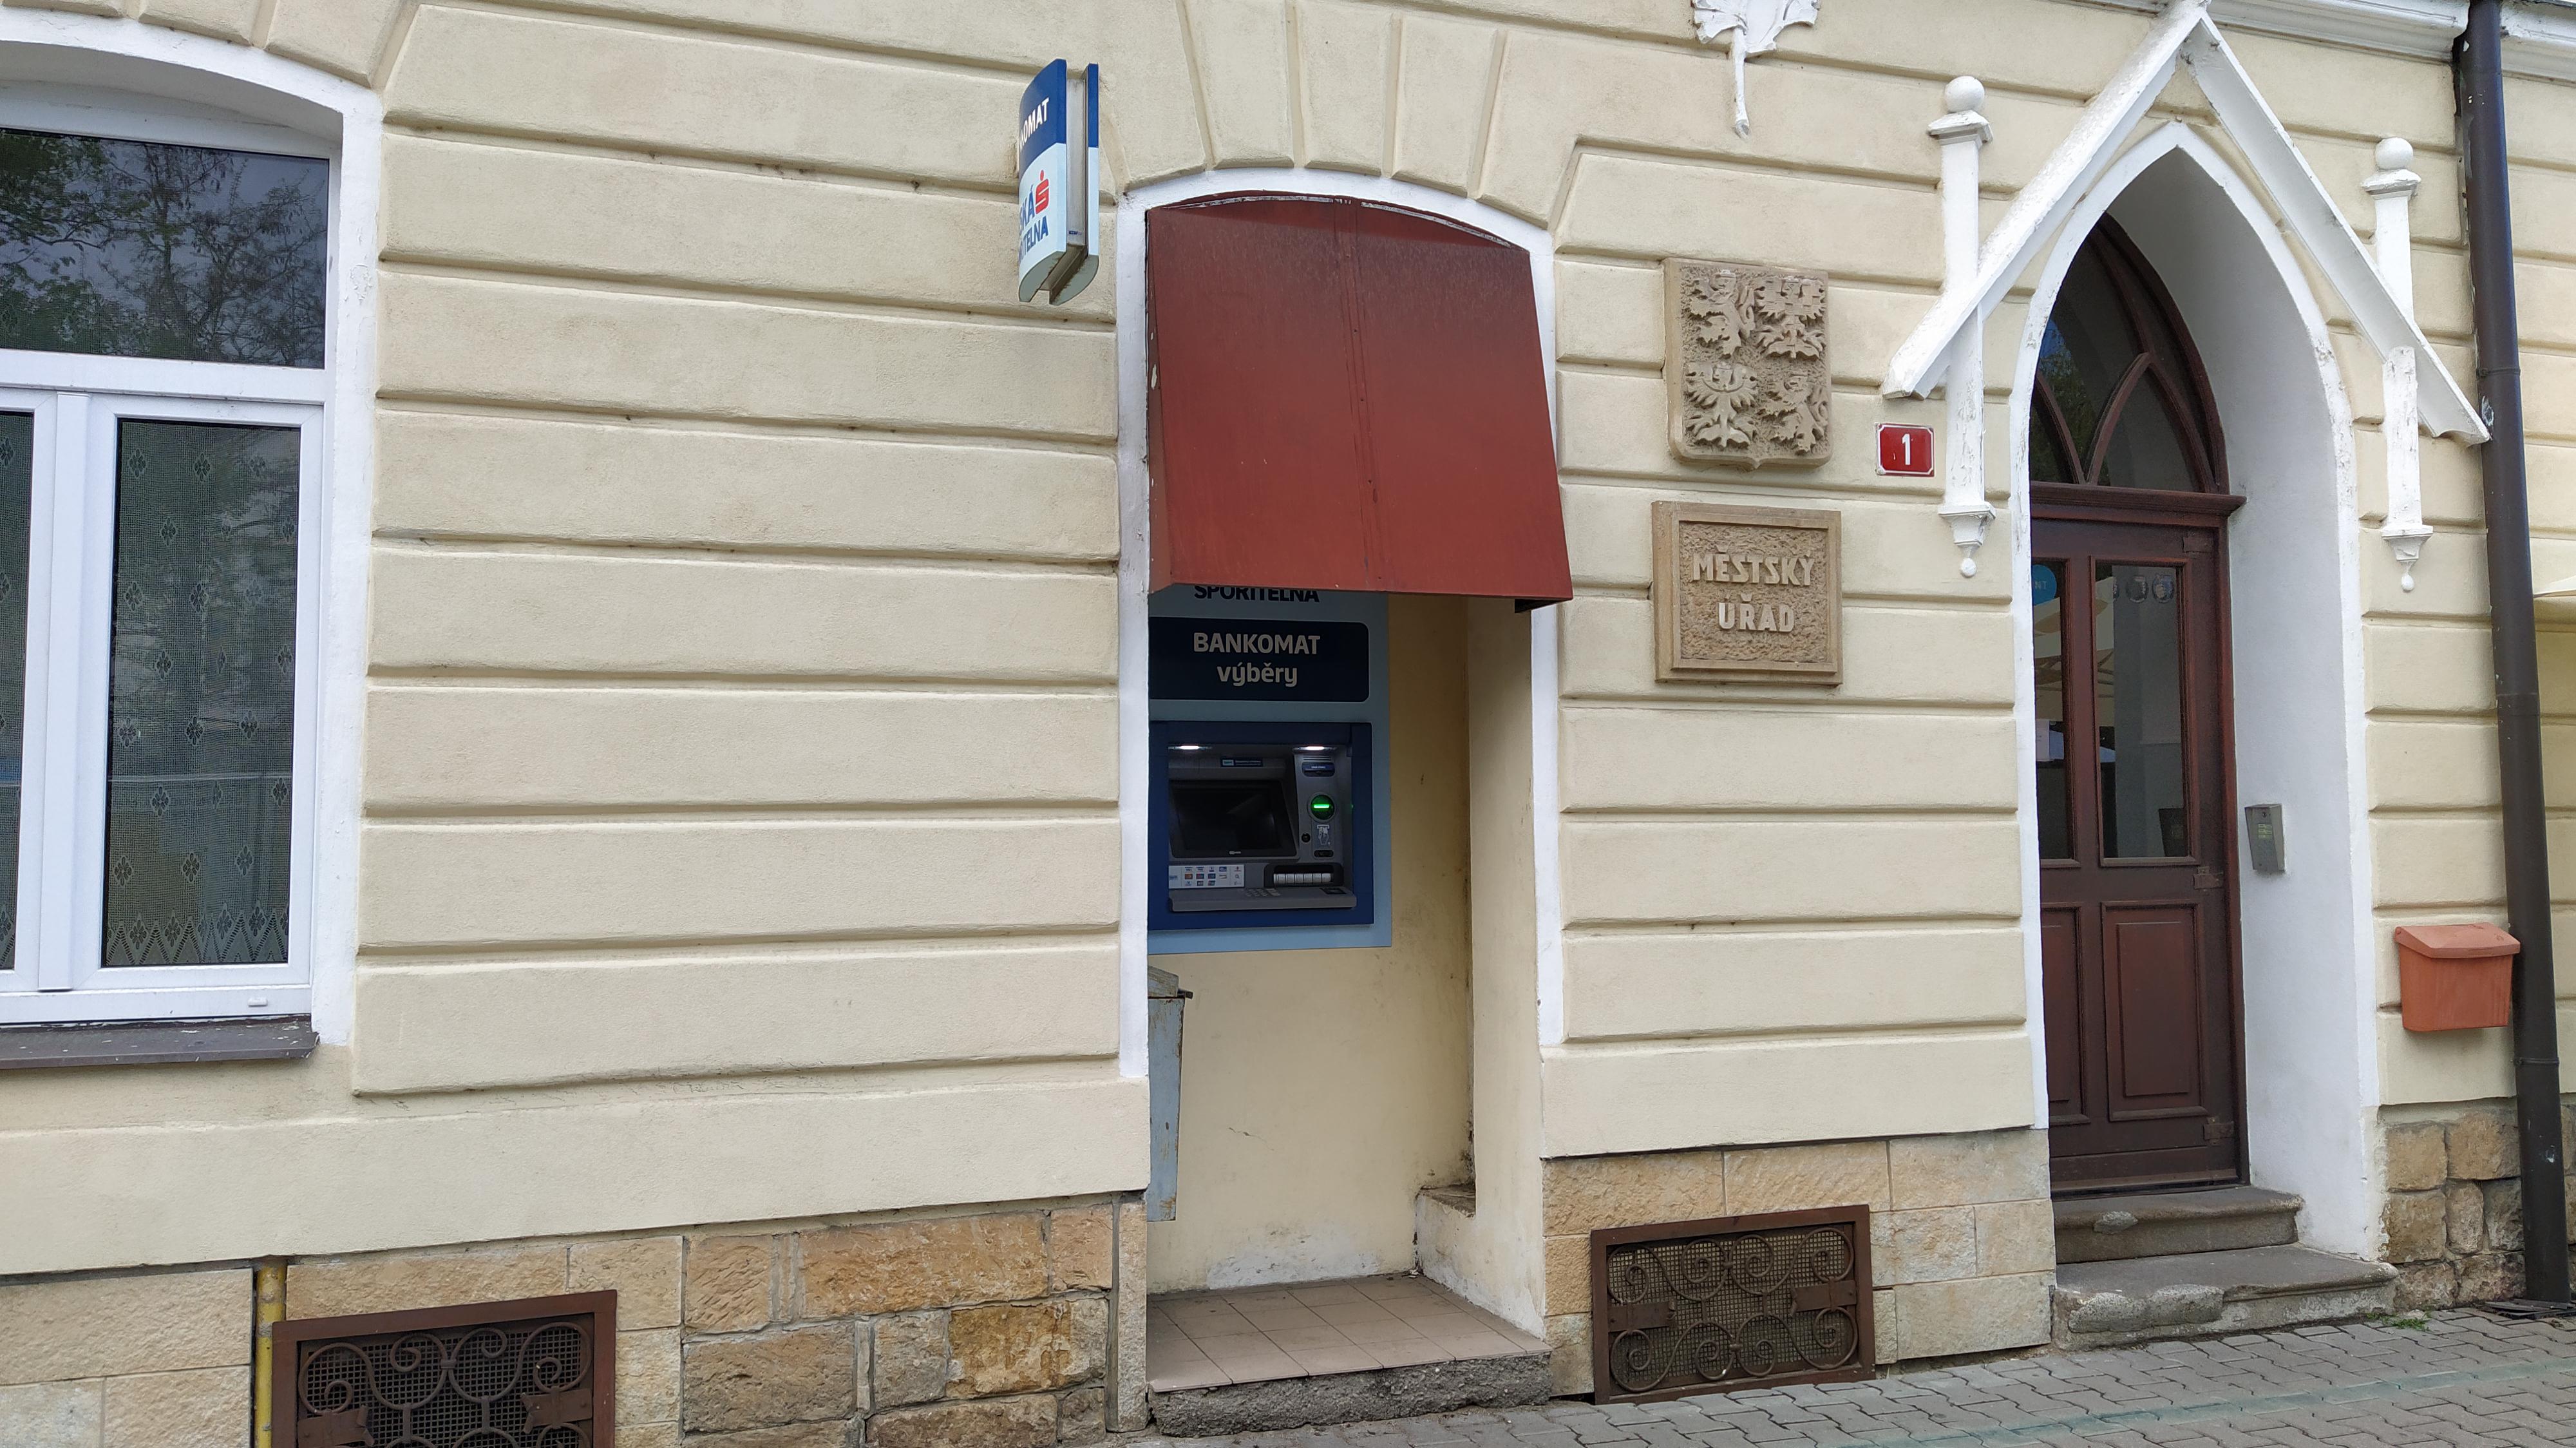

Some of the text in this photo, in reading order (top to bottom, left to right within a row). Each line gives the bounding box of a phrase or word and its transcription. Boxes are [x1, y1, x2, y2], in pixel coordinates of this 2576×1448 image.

[1902, 433, 1911, 466] 1
[1692, 545, 1815, 586] MĚSTSKÝ
[1718, 592, 1795, 633] ÚŘAD
[1194, 633, 1320, 654] BANKOMAT
[1217, 662, 1298, 687] výběry
